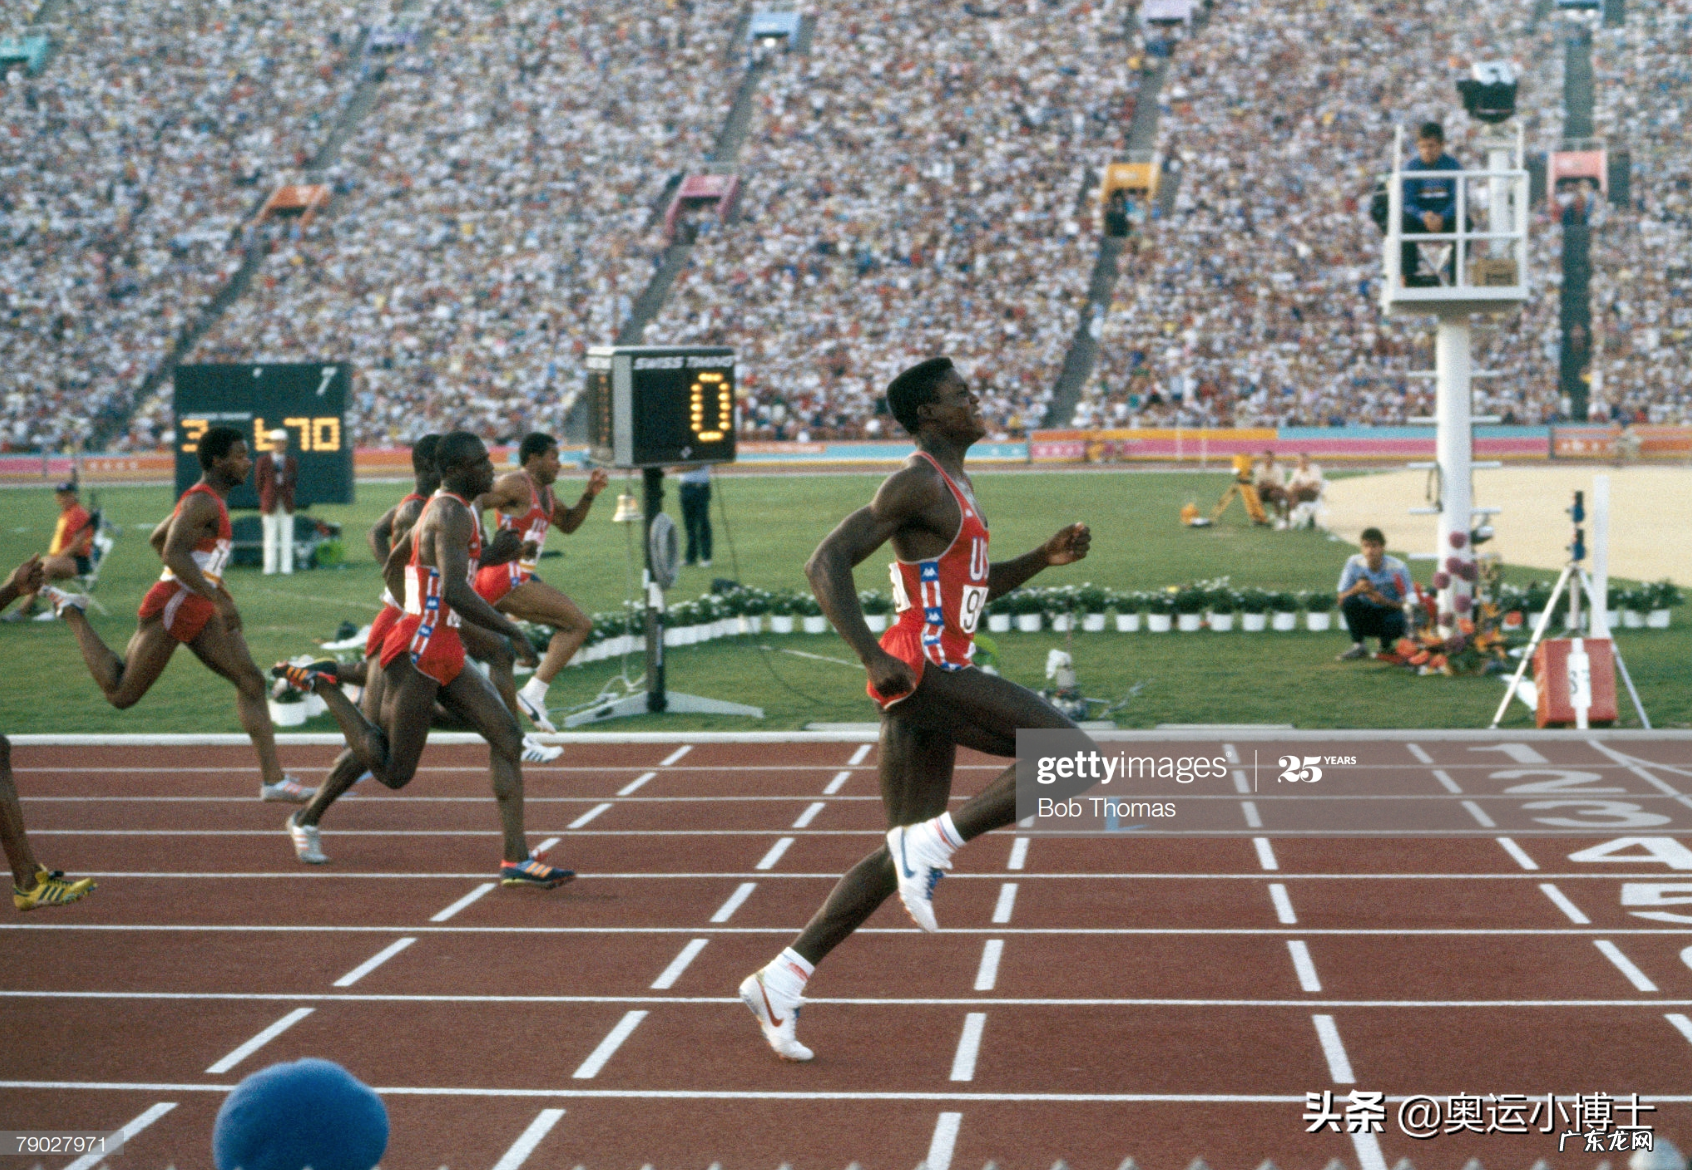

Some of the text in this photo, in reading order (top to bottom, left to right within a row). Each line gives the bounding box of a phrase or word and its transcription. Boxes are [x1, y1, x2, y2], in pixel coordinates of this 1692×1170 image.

[690, 372, 732, 443] 0
[1487, 769, 1627, 793] 2
[1521, 800, 1672, 828] 3
[1567, 837, 1692, 870] 4
